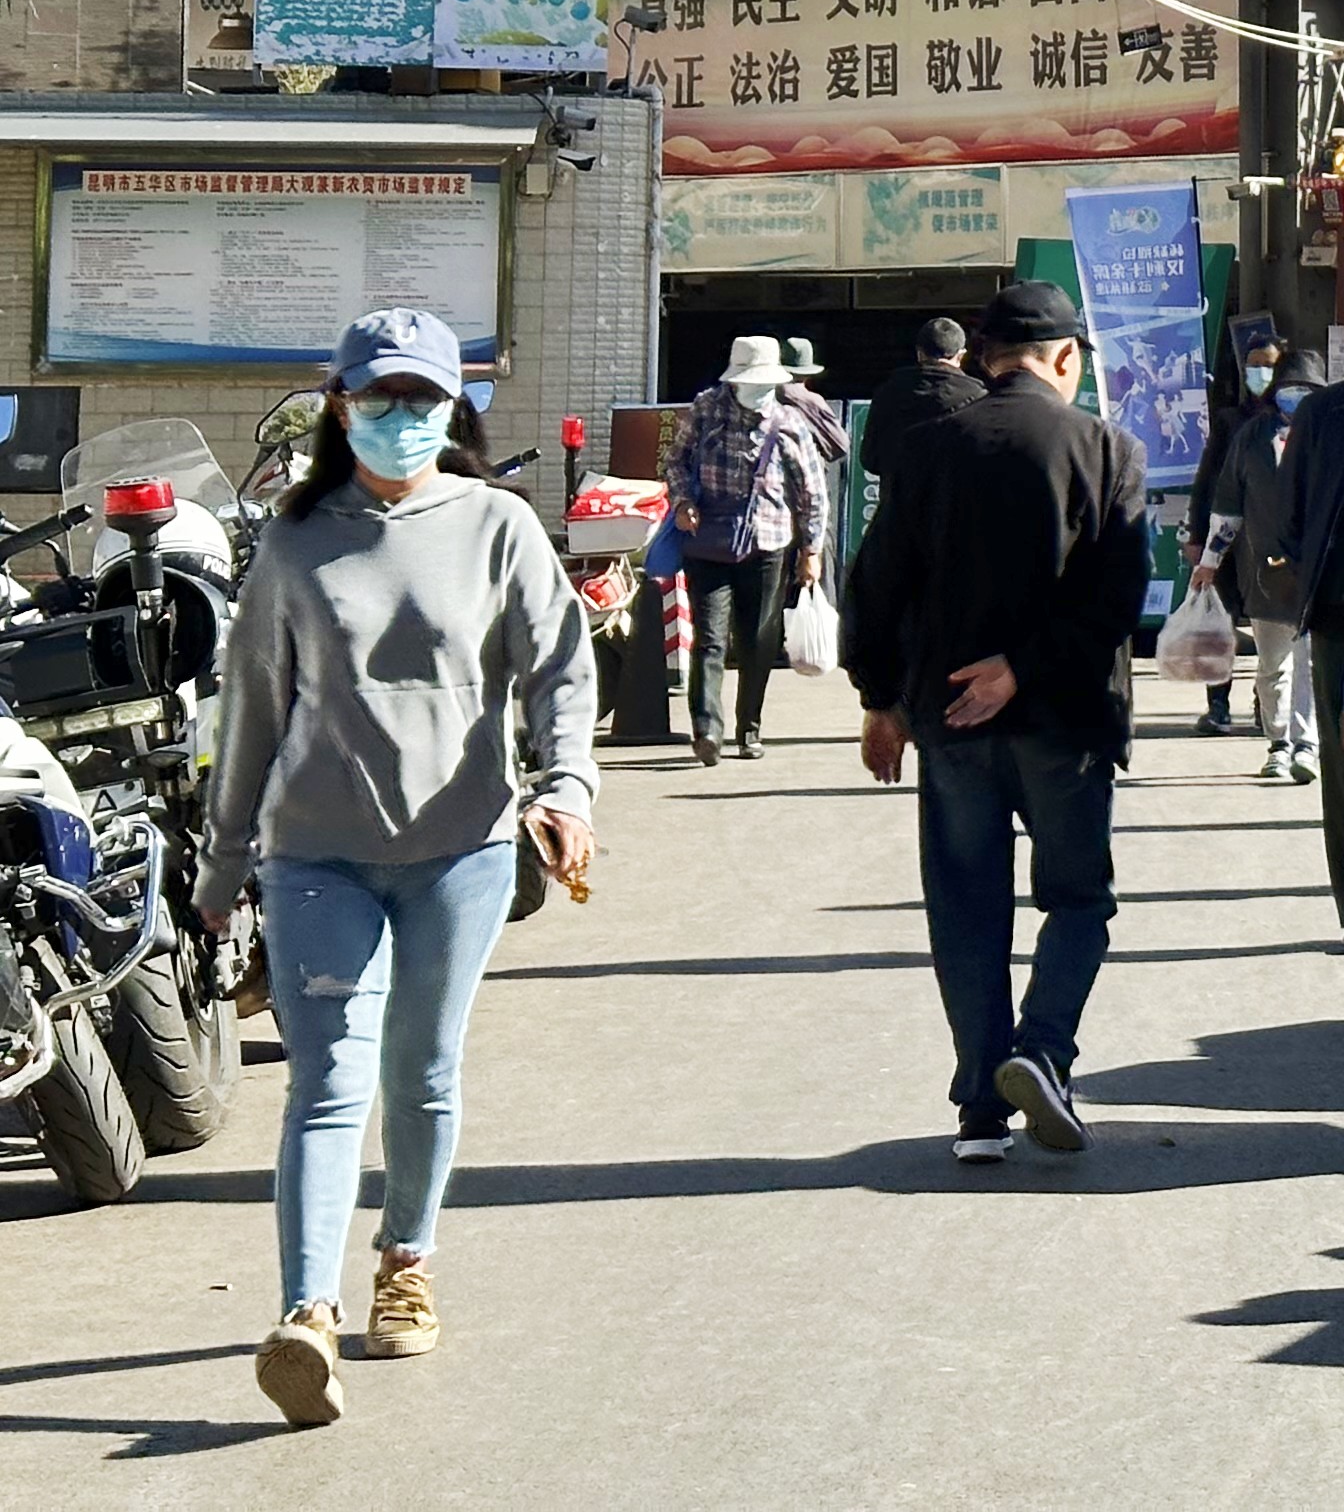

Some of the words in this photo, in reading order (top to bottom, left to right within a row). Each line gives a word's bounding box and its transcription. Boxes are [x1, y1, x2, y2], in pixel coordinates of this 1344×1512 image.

[635, 55, 705, 109] 公正
[729, 48, 801, 106] 法治
[826, 43, 899, 99] 爱国
[926, 37, 1002, 93] 敬业
[1030, 28, 1108, 89] 诚信
[1136, 23, 1219, 85] 友善
